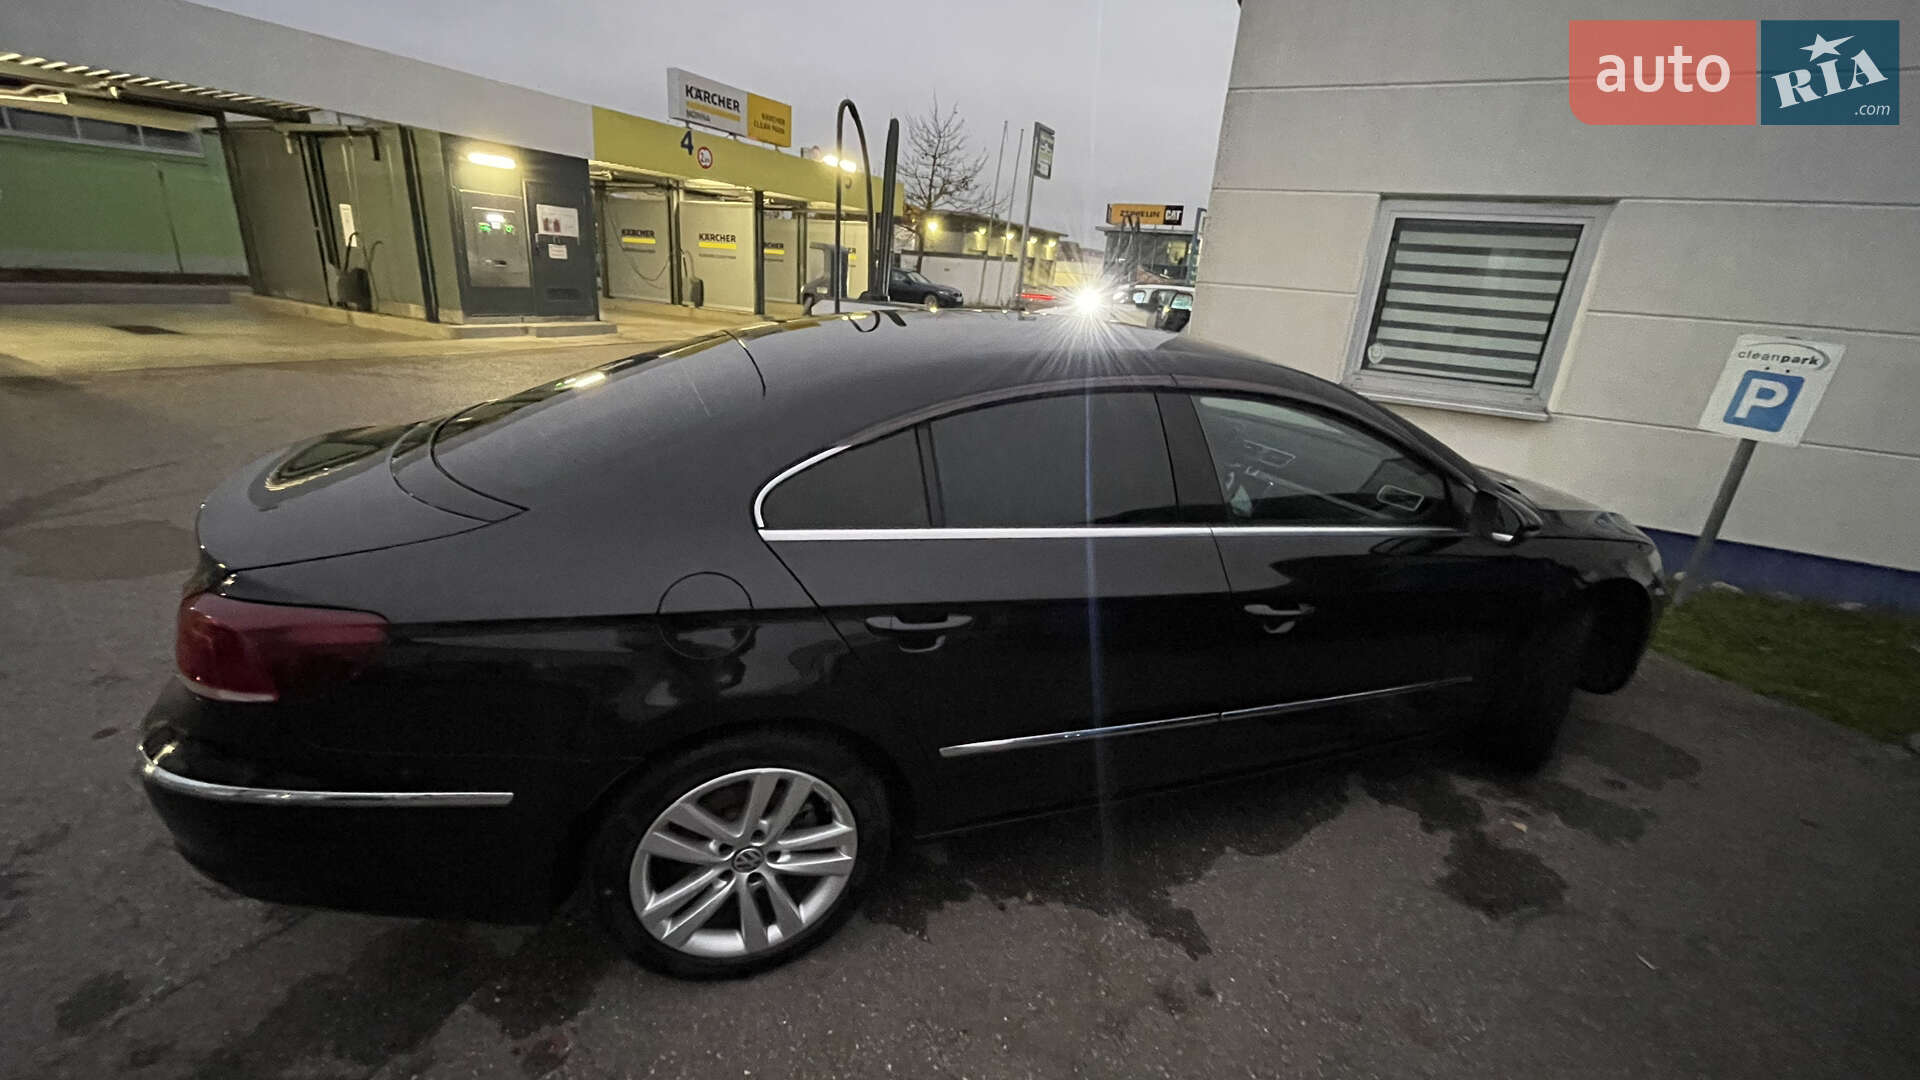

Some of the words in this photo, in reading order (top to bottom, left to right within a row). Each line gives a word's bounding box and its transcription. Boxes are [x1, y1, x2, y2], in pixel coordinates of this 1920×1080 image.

[685, 84, 740, 113] KÄRCHER
[681, 130, 694, 156] 4
[1165, 210, 1181, 221] CAT
[699, 233, 736, 242] KÄRCHER
[1738, 350, 1820, 366] cleanpark
[1734, 378, 1789, 418] P
